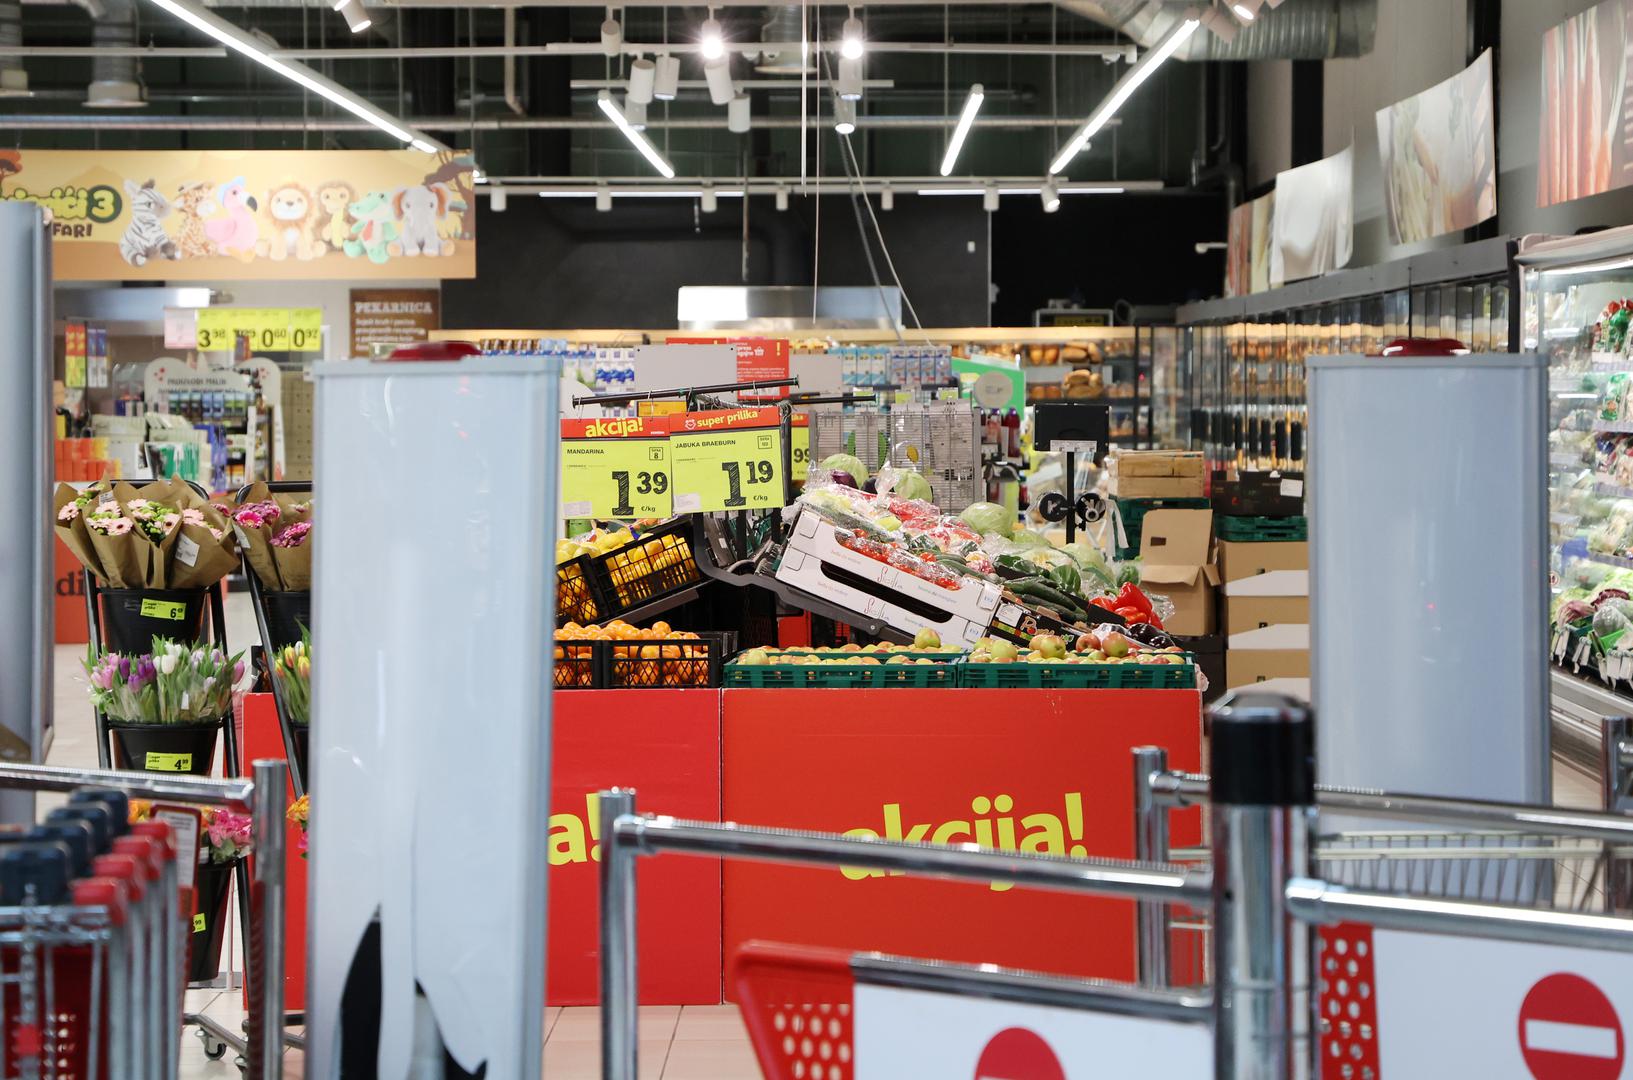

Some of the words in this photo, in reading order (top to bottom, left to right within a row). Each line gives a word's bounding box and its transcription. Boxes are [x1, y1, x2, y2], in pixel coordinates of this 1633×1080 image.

[354, 302, 433, 314] PEKARNICA
[199, 329, 212, 348] 3
[262, 329, 274, 348] 0
[294, 329, 305, 348] 0
[585, 417, 643, 438] akcija!
[697, 416, 724, 428] super
[727, 409, 758, 425] prilika
[675, 441, 701, 449] JABUKA
[701, 439, 736, 447] BRAEBURN
[722, 461, 747, 507] 1
[746, 460, 774, 485] 19
[611, 471, 634, 516] 1
[636, 471, 668, 494] 39
[753, 494, 768, 502] €/kg
[641, 503, 656, 513] €/kg
[170, 607, 177, 618] 6
[174, 759, 182, 770] 4
[839, 791, 1087, 892] akcija!
